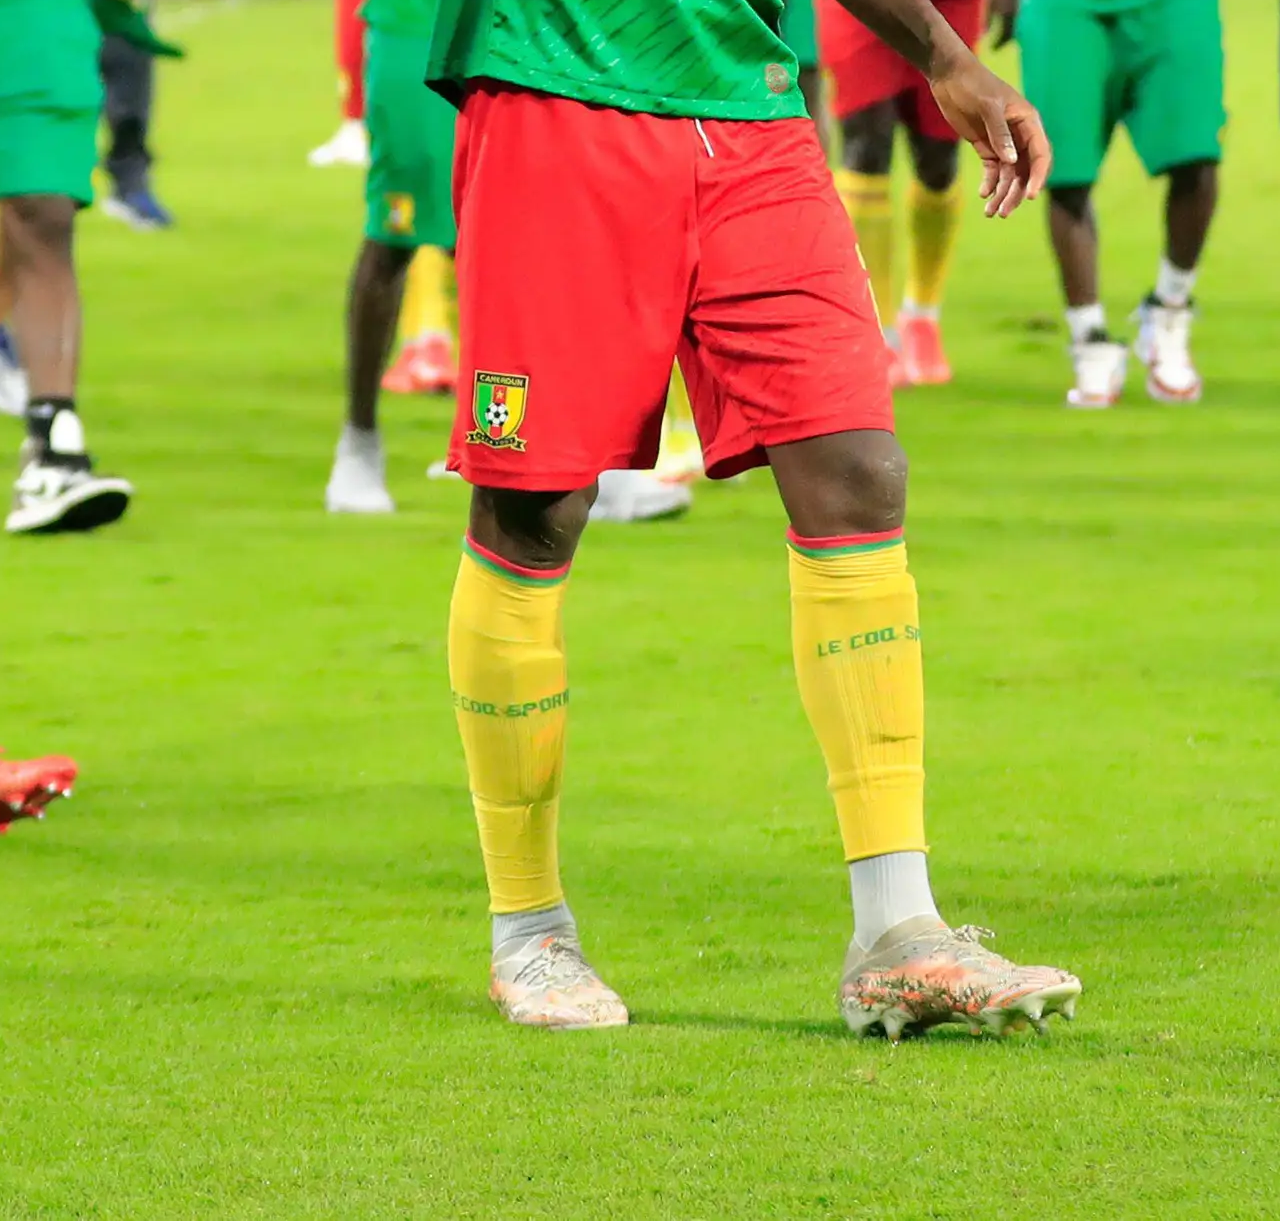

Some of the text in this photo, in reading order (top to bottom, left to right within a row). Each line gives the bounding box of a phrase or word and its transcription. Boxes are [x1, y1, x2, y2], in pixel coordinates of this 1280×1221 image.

[479, 373, 524, 387] CAMEROUN
[816, 639, 843, 658] LE
[849, 626, 898, 651] COQ
